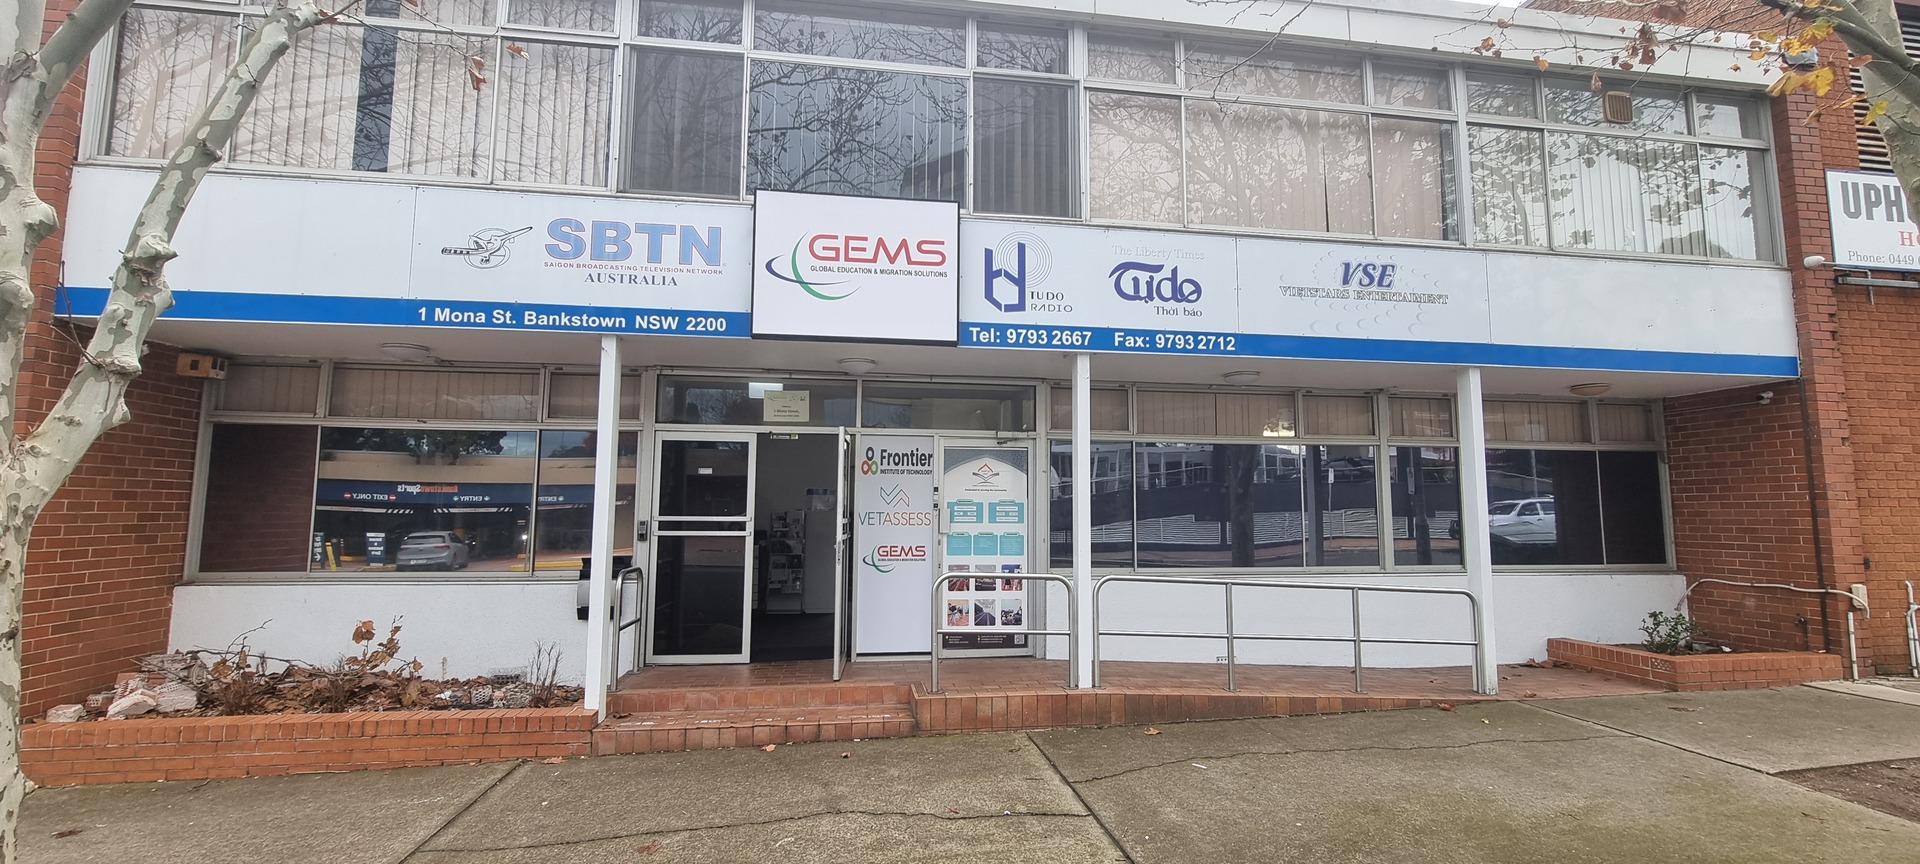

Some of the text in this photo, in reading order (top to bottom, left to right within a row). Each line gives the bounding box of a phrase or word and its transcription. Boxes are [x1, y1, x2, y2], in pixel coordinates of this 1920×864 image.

[544, 217, 722, 267] SBTN
[1898, 230, 1920, 247] H
[808, 233, 947, 267] GEMS
[1111, 244, 1205, 260] The Liberty Times
[1847, 250, 1885, 263] Phone:
[1888, 253, 1915, 266] 0449
[543, 261, 574, 269] SAIGON
[576, 263, 638, 272] BROADCASTING
[640, 266, 685, 274] TELEVISION
[810, 265, 836, 273] GLOBAL
[879, 268, 913, 276] MIGRATION
[914, 270, 948, 278] SOLUTIONS
[1340, 260, 1396, 289] VSE
[584, 272, 678, 286] AUSTRALIA
[1029, 290, 1064, 301] TUDO
[1030, 303, 1073, 313] RADIO
[1183, 307, 1203, 317] báo
[418, 306, 727, 331] 1 Mona St. Bankstown NSW 2200
[969, 326, 1236, 351] Tel: 9793 2667 Fax: 9793 2712
[880, 447, 933, 467] Frontier
[858, 511, 932, 526] VETASSESS
[877, 545, 926, 557] GEMS
